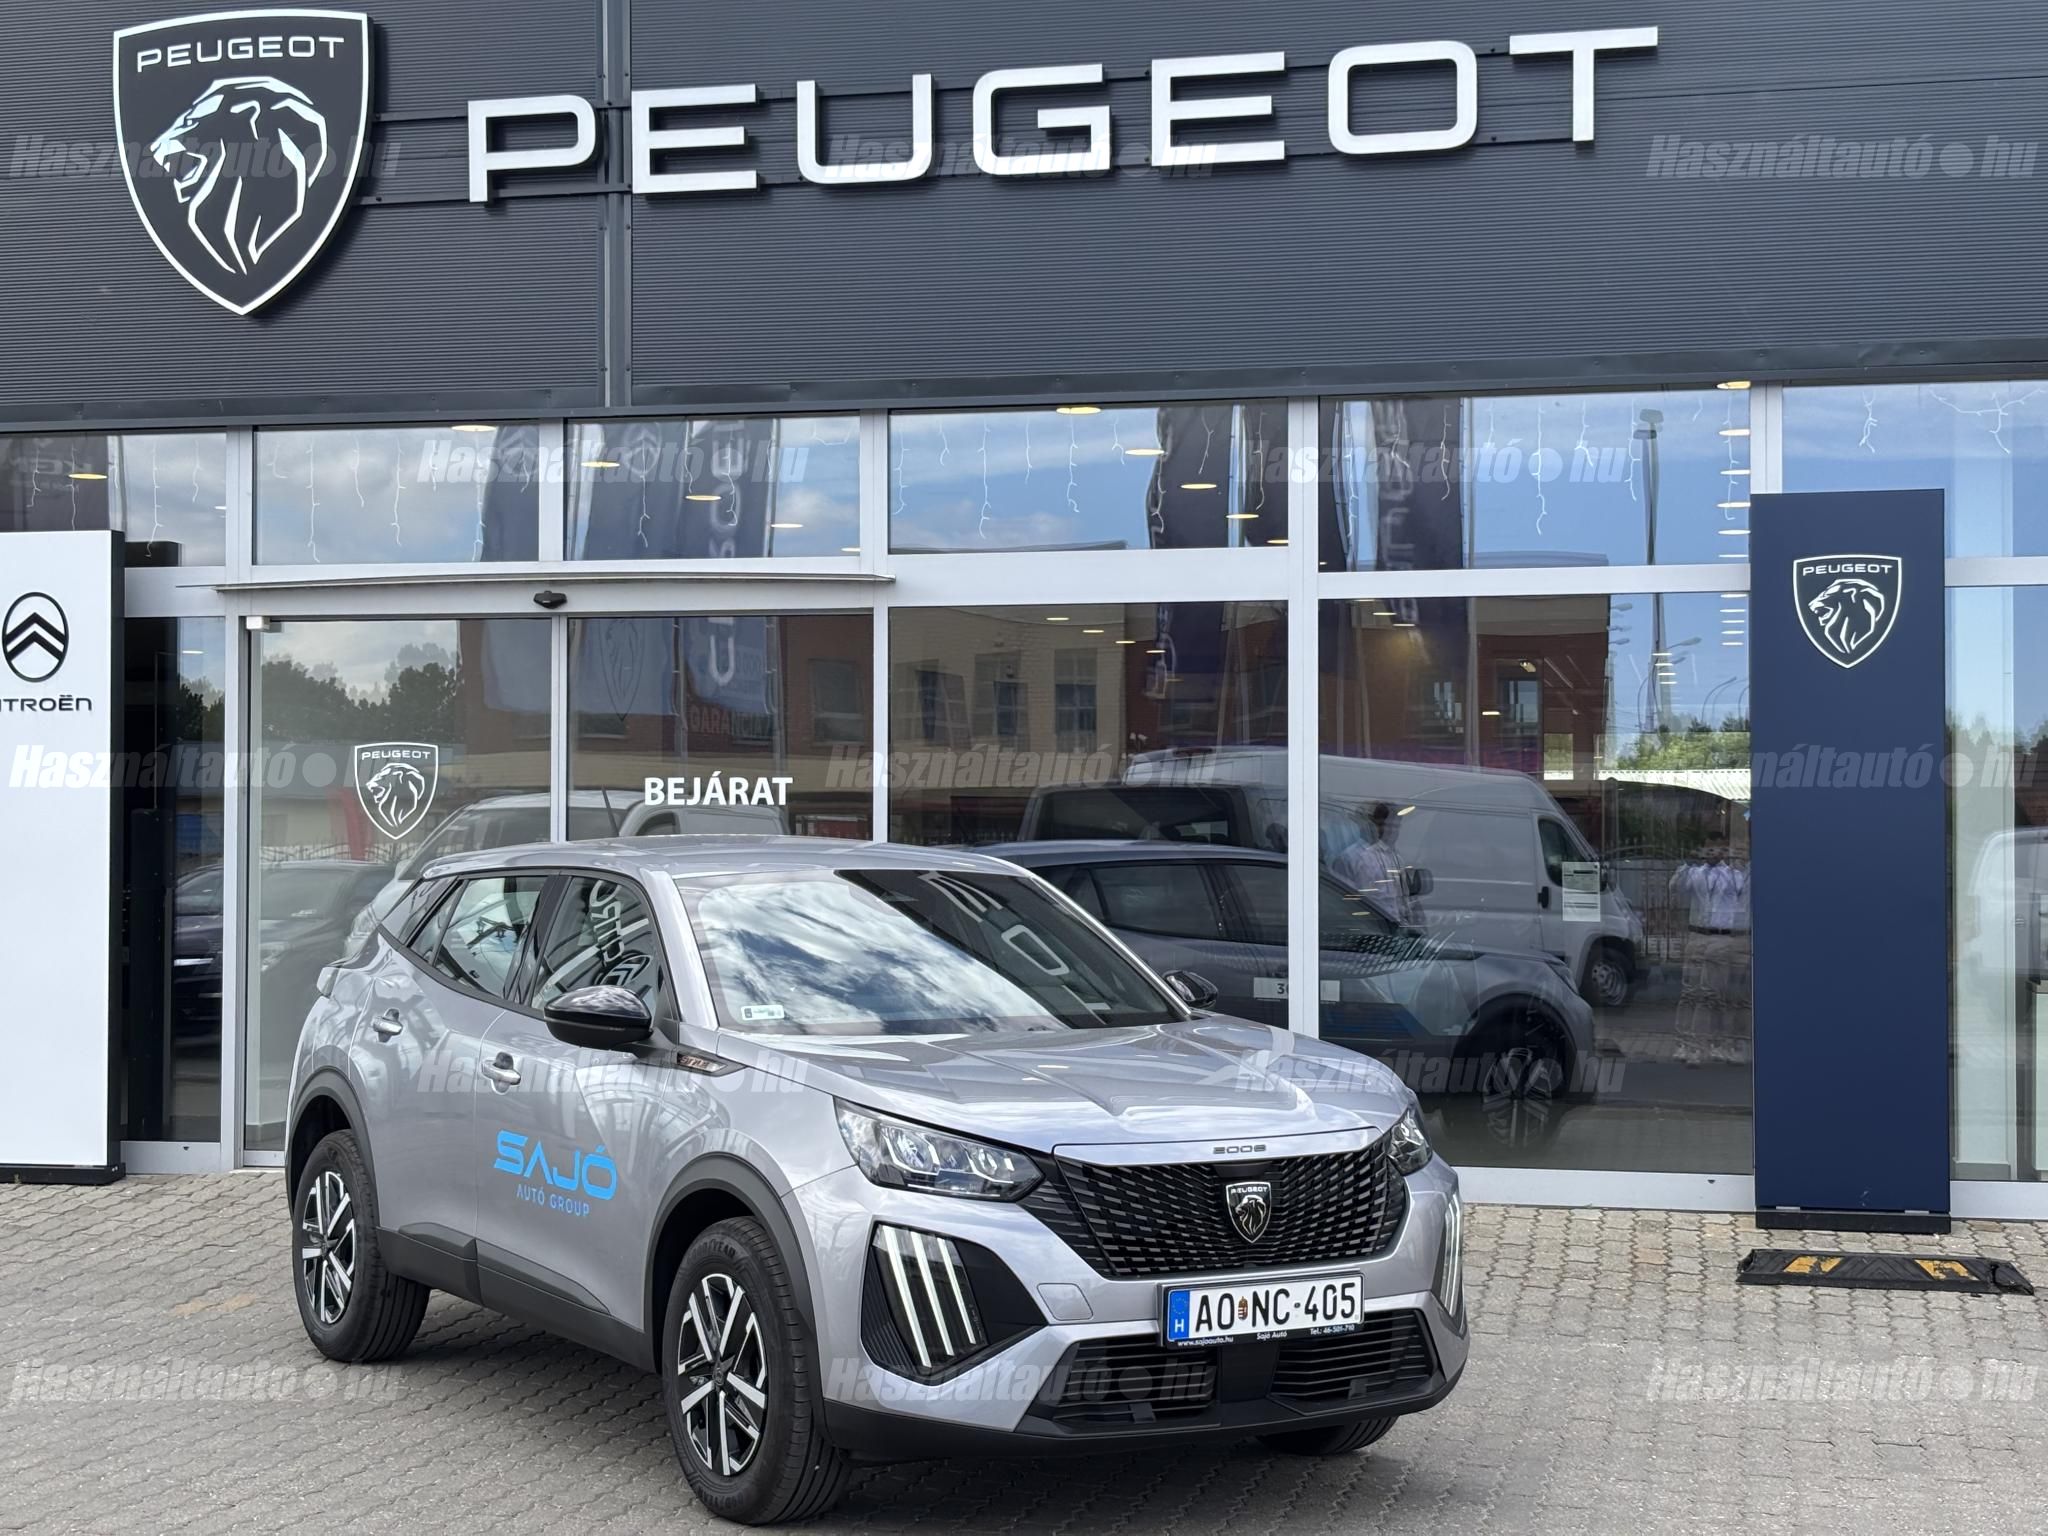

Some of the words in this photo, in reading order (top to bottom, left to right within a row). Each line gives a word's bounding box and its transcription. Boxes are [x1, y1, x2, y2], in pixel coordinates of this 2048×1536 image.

[136, 35, 345, 72] PEUGEOT
[468, 26, 1658, 203] PEUGEOT
[1802, 562, 1893, 576] PEUGEOT
[361, 750, 431, 760] PEUGEOT
[644, 770, 793, 806] BEJÁRAT
[1213, 1144, 1267, 1155] 2008
[493, 1129, 618, 1201] SAJÓ
[516, 1183, 545, 1206] AUTÓ
[550, 1193, 591, 1217] GROUP
[1230, 1186, 1269, 1195] PEUGEOT
[1174, 1318, 1185, 1333] H
